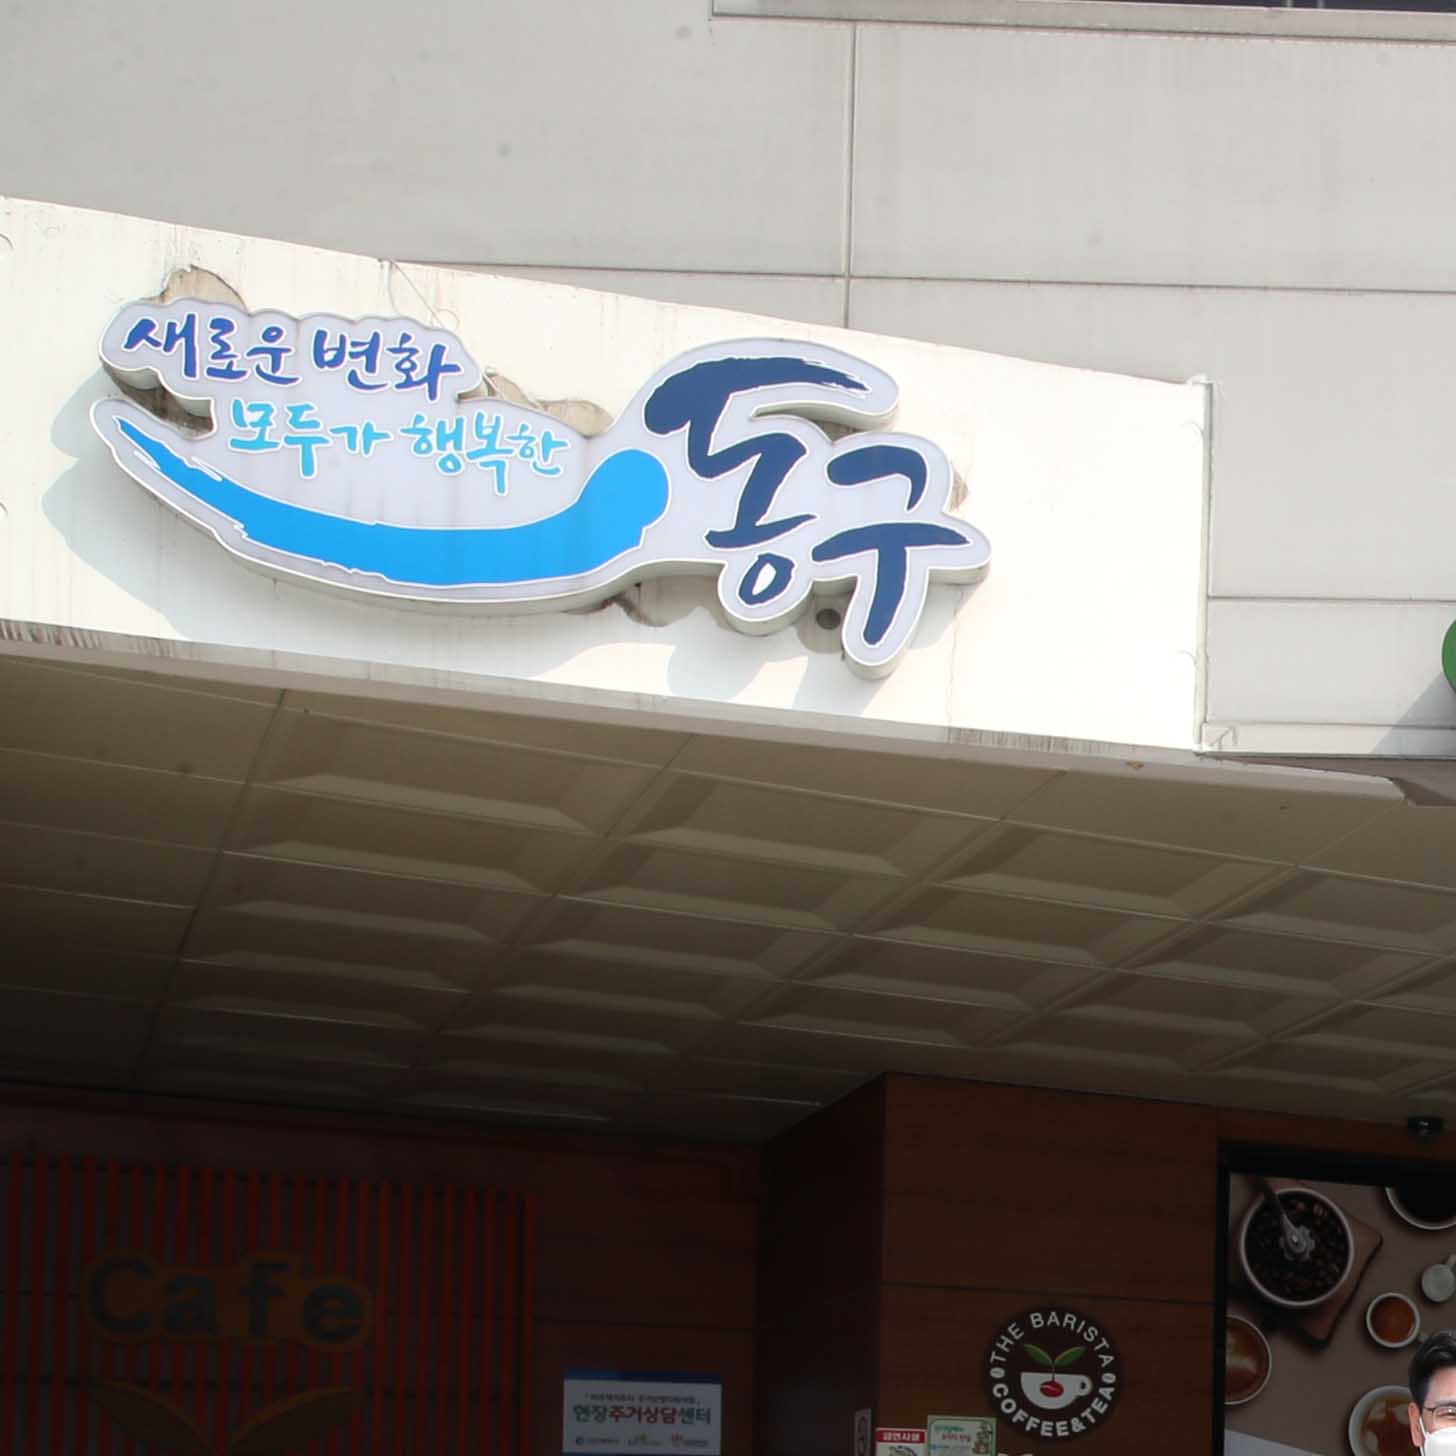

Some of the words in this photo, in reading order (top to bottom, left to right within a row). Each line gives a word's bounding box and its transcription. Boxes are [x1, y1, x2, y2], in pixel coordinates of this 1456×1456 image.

[123, 312, 301, 386] 새로운
[312, 318, 464, 403] 변화
[230, 399, 391, 479] 모두가
[402, 413, 570, 496] 행복한
[643, 355, 971, 644] 동구
[89, 1257, 366, 1340] Cafe
[989, 1322, 1025, 1364] THE
[1029, 1311, 1115, 1367] BARISTA
[573, 1404, 711, 1425] 현장주거상담센터
